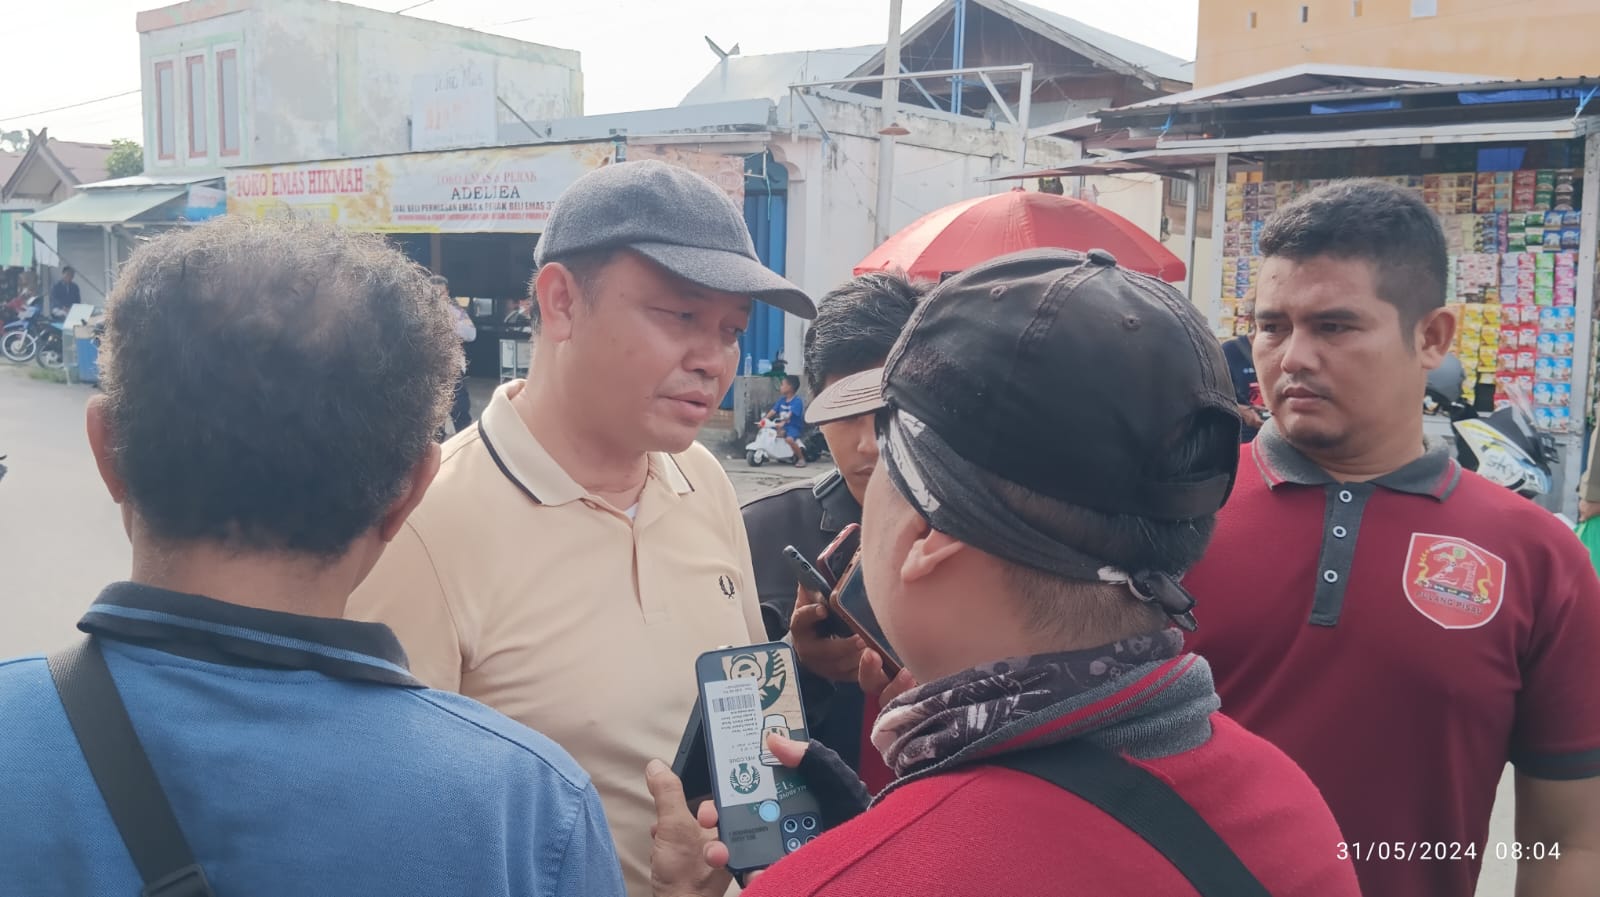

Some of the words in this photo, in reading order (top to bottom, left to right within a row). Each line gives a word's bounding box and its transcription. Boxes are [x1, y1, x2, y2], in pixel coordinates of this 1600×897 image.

[236, 174, 268, 197] TOKO
[272, 171, 305, 195] EMAS
[308, 167, 363, 194] HIKMAH
[451, 185, 520, 200] ADELIEA
[1416, 590, 1453, 606] PULANG
